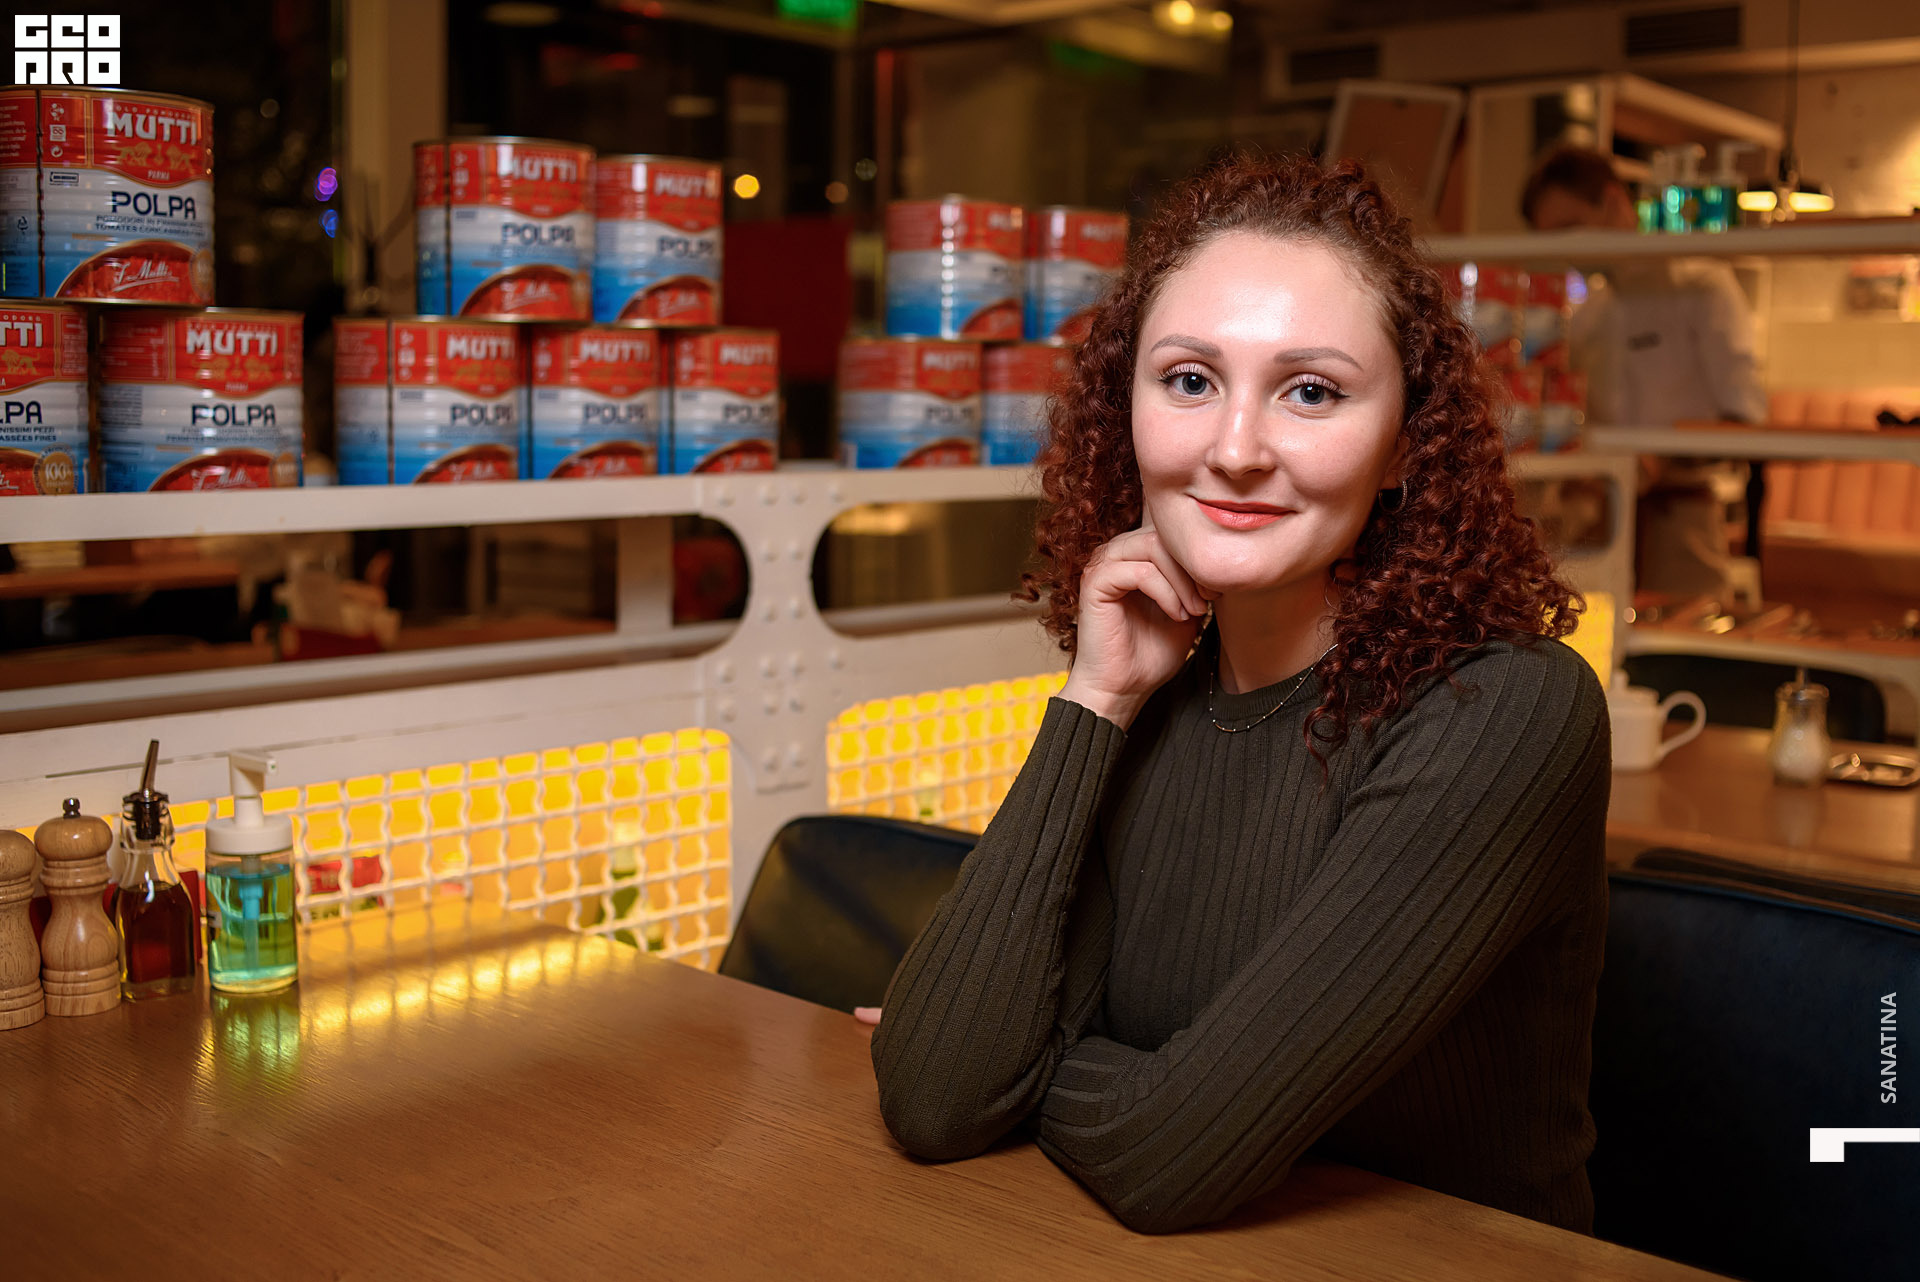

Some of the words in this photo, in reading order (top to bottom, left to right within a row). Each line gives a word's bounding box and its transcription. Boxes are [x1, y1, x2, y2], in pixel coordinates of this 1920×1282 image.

[107, 110, 197, 146] MUTTI
[111, 190, 196, 221] POLPA
[186, 328, 278, 357] MUTTI
[446, 335, 516, 361] MUTTI
[0, 400, 43, 424] PA
